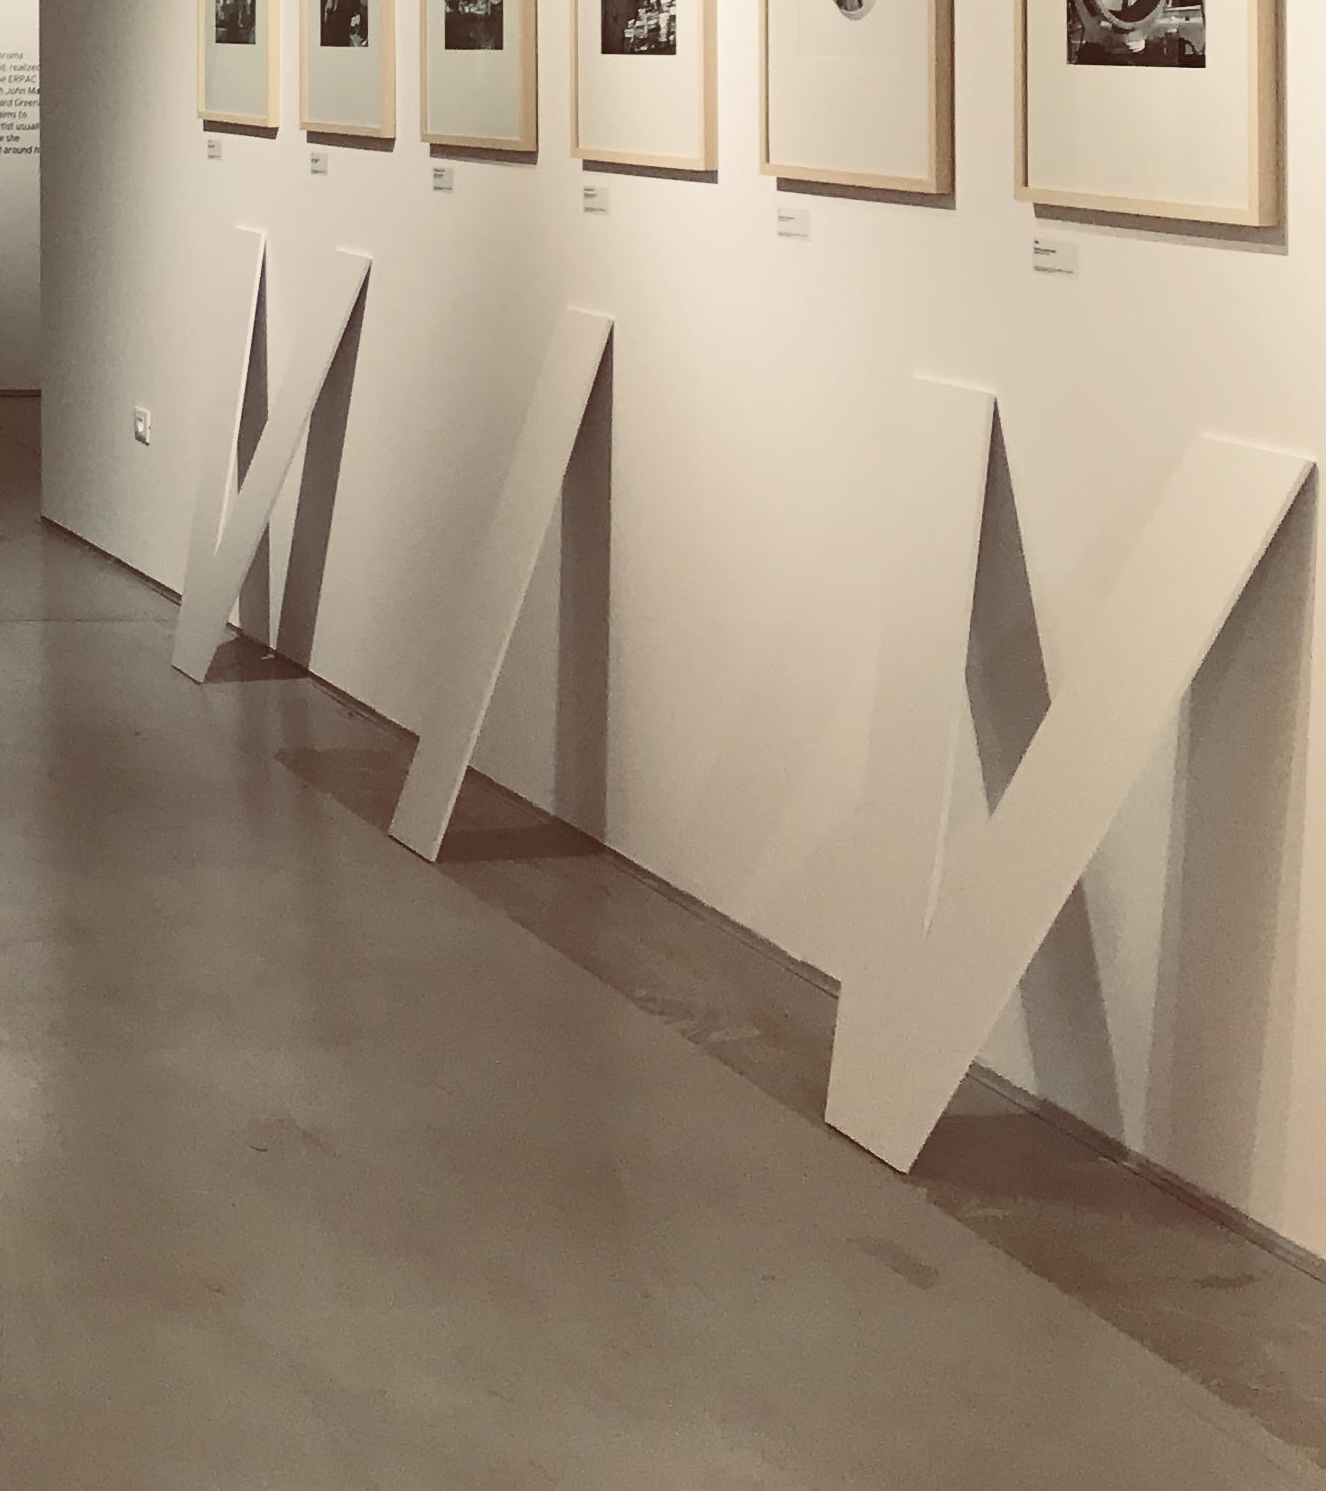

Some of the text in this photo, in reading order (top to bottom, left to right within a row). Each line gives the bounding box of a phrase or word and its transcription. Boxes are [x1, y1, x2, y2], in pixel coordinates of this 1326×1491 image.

[5, 87, 25, 95] John
[19, 110, 27, 119] to
[6, 134, 20, 142] she
[3, 146, 33, 155] around
